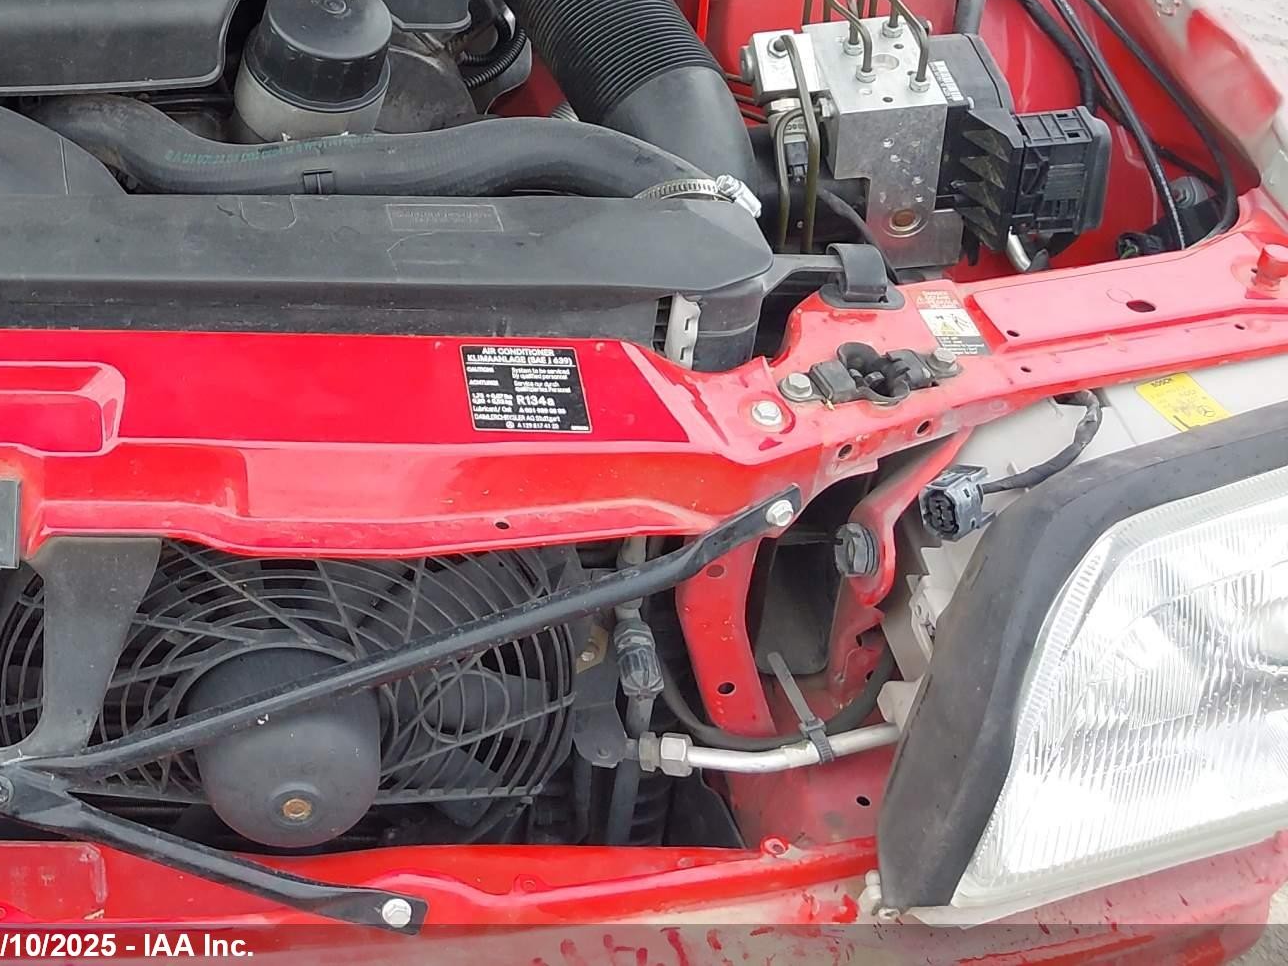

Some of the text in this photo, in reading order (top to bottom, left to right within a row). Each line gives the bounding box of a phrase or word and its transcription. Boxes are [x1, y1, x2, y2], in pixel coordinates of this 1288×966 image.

[498, 348, 554, 356] CONDITIONER
[467, 355, 526, 363] KLIMAANLAGE
[516, 395, 555, 406] R134a
